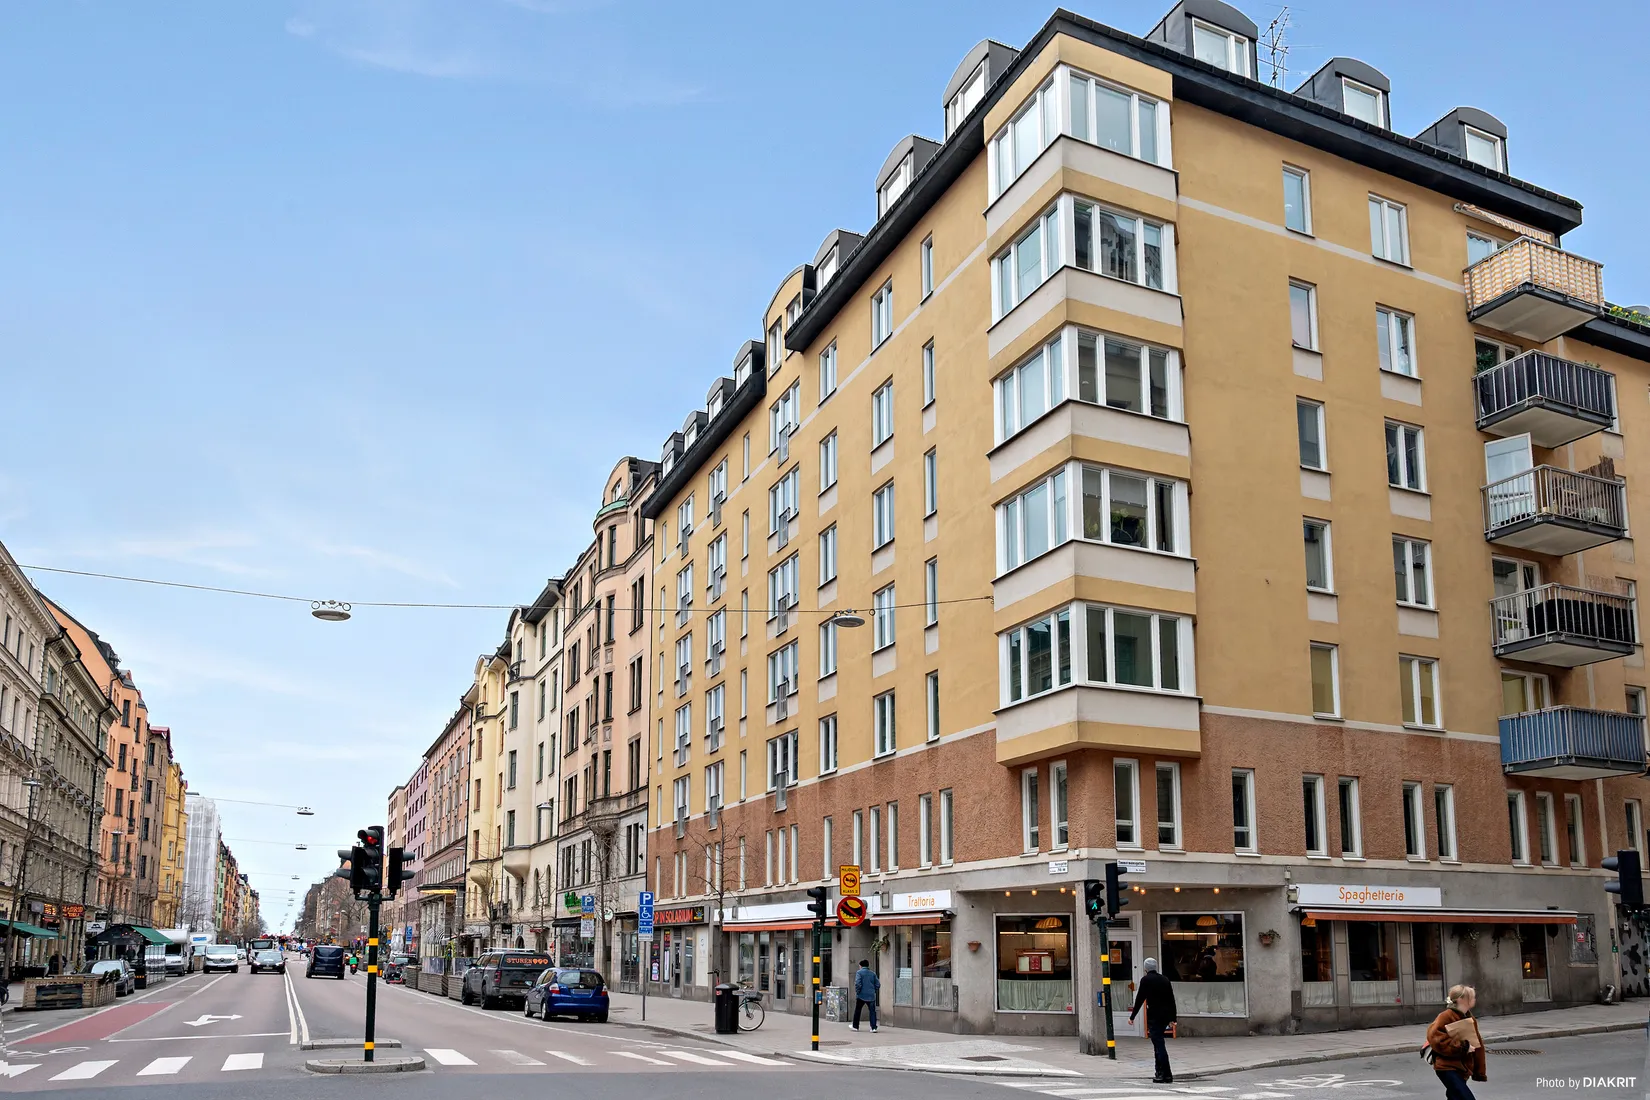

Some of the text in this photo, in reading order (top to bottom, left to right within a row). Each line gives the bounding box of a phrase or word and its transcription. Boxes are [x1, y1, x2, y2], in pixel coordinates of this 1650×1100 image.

[643, 893, 651, 904] P
[1339, 885, 1404, 904] Spaghetteria
[584, 896, 592, 906] P
[908, 895, 935, 907] Trattoria
[659, 911, 665, 924] IN
[665, 908, 693, 923] SOLARIUM
